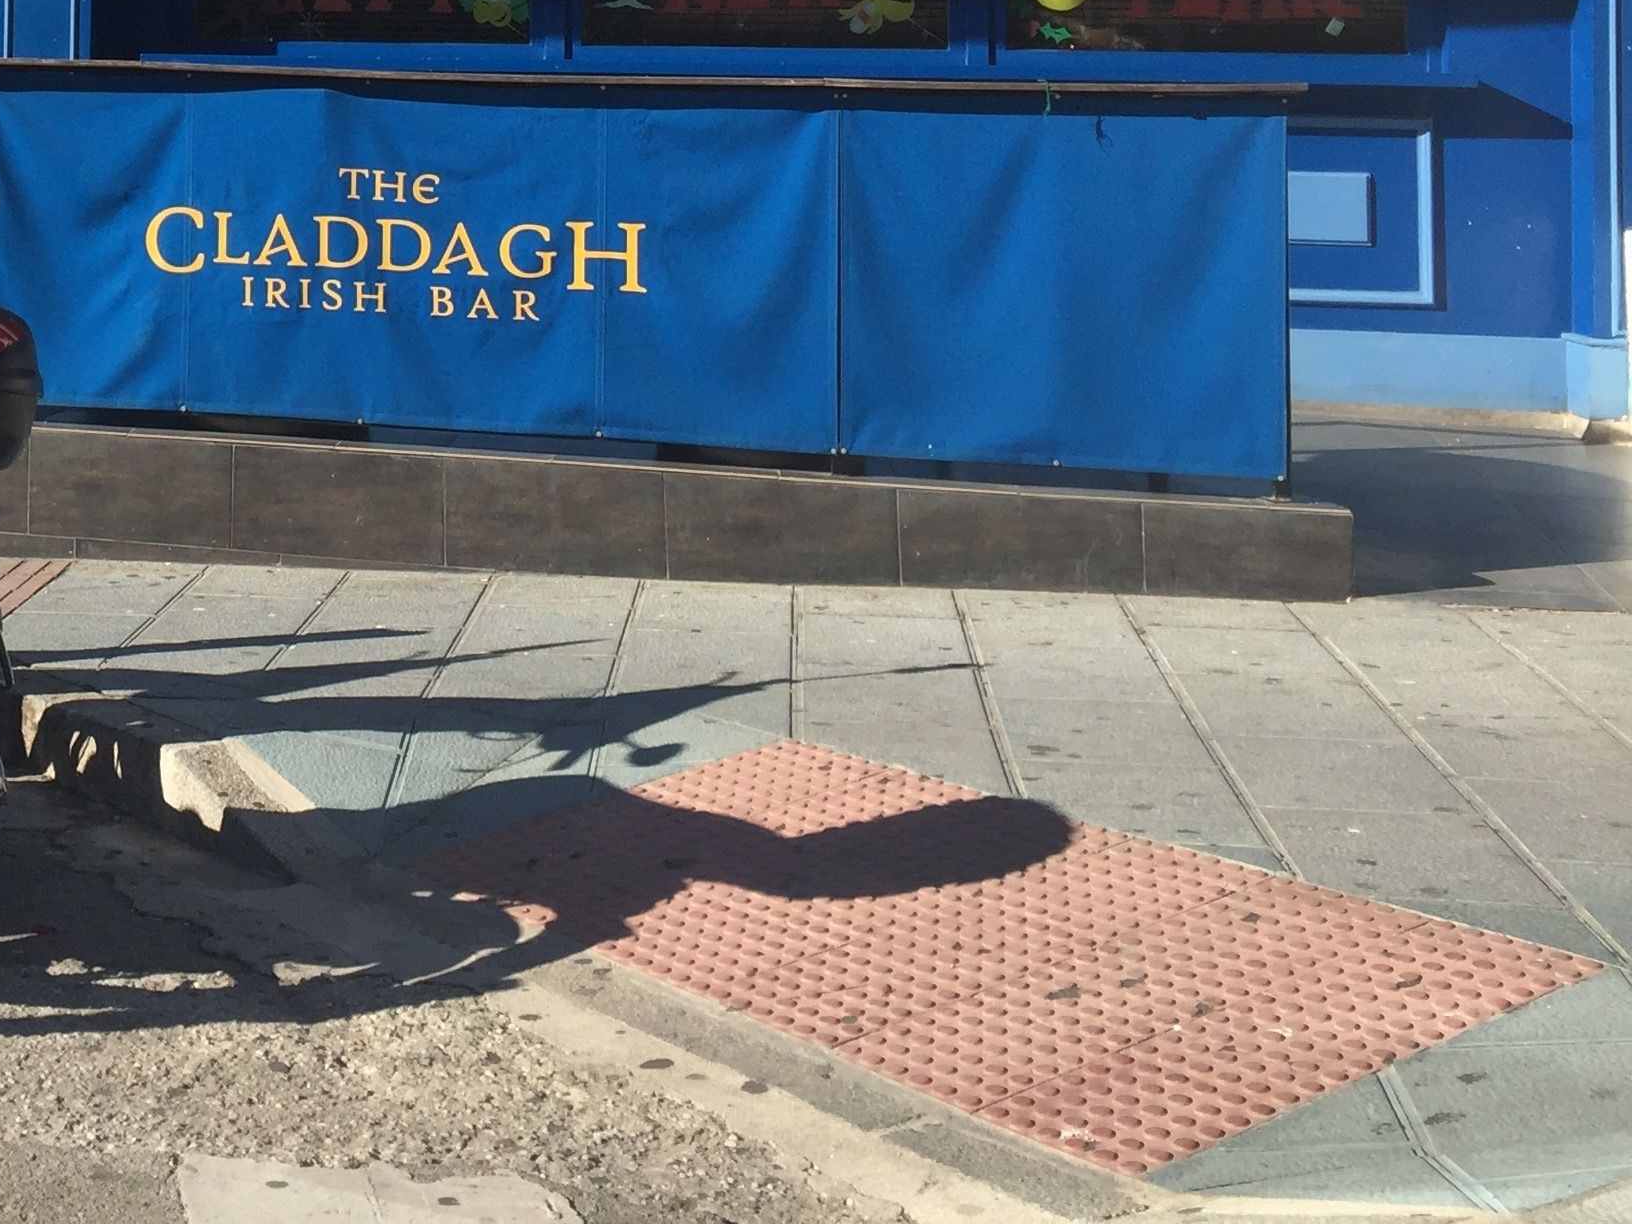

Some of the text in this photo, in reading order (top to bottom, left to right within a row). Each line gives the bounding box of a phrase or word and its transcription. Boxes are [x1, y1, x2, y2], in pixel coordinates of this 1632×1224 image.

[338, 167, 440, 204] THE
[144, 206, 648, 294] CLADDAGH
[241, 276, 540, 322] IRISH BAR
